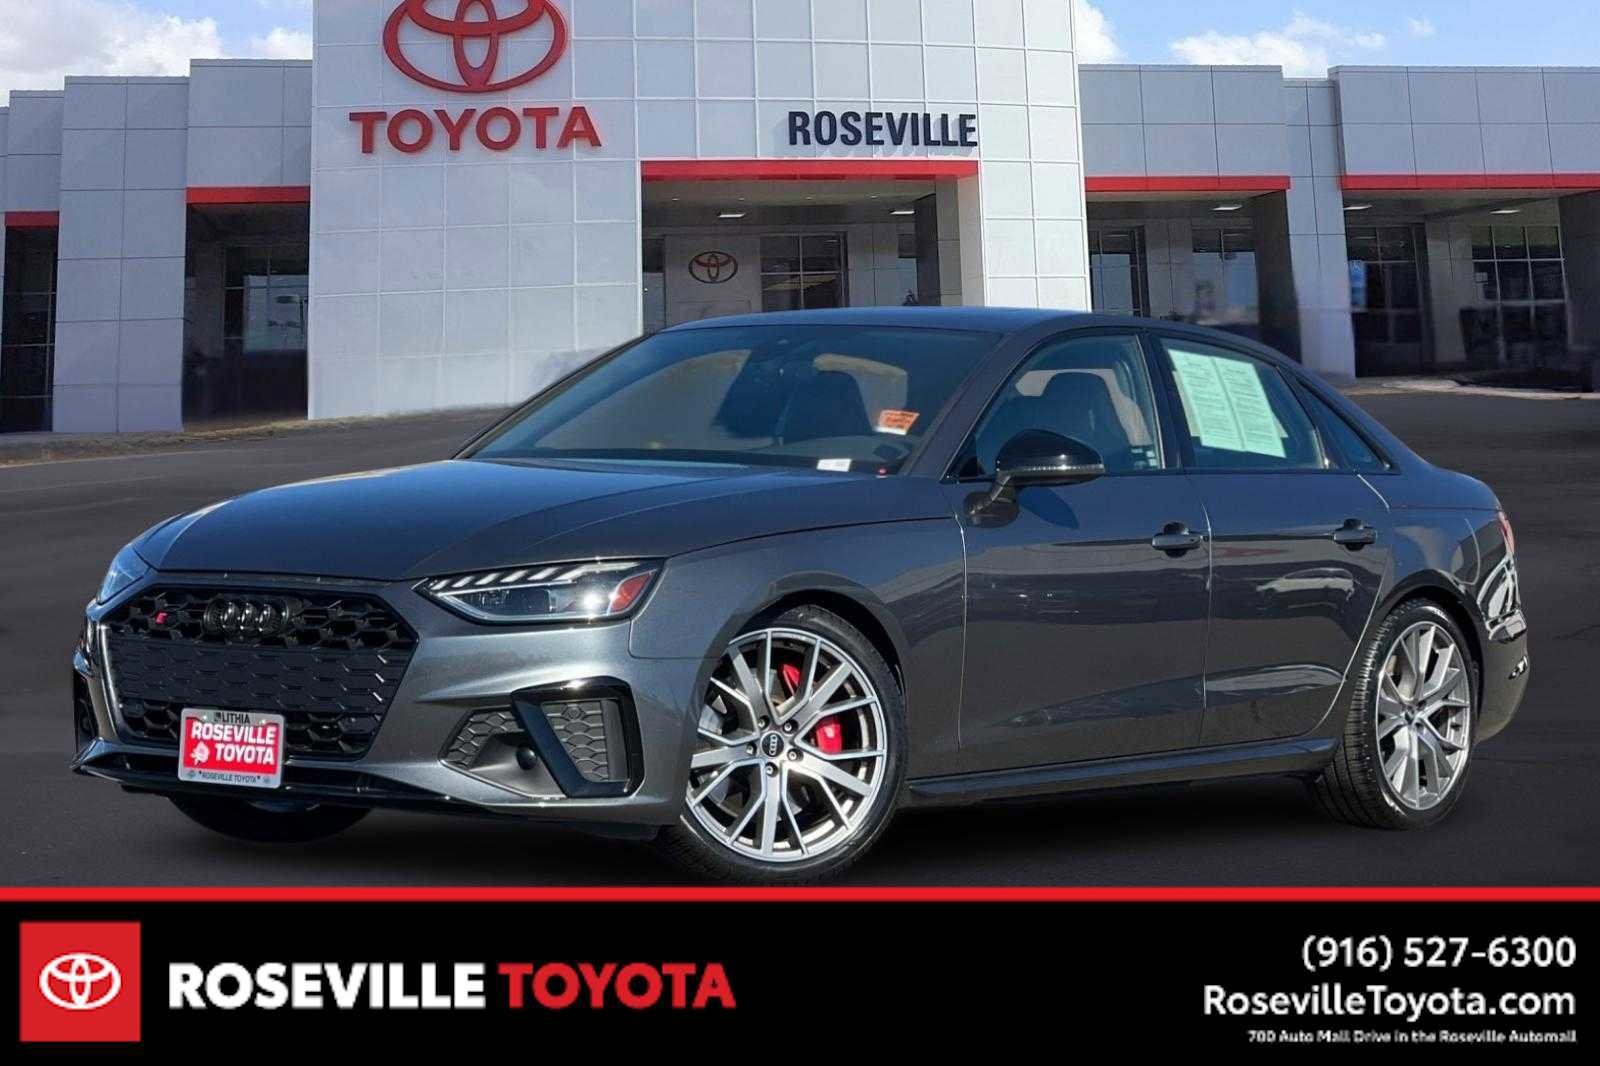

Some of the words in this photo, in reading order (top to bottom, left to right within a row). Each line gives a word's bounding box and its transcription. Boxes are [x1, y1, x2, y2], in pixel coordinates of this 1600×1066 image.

[350, 106, 602, 153] TOYOTA
[788, 111, 978, 147] ROSEVILLE
[221, 712, 251, 724] LITHIA
[191, 721, 277, 744] ROSEVILLE
[214, 743, 275, 765] TOYOTA
